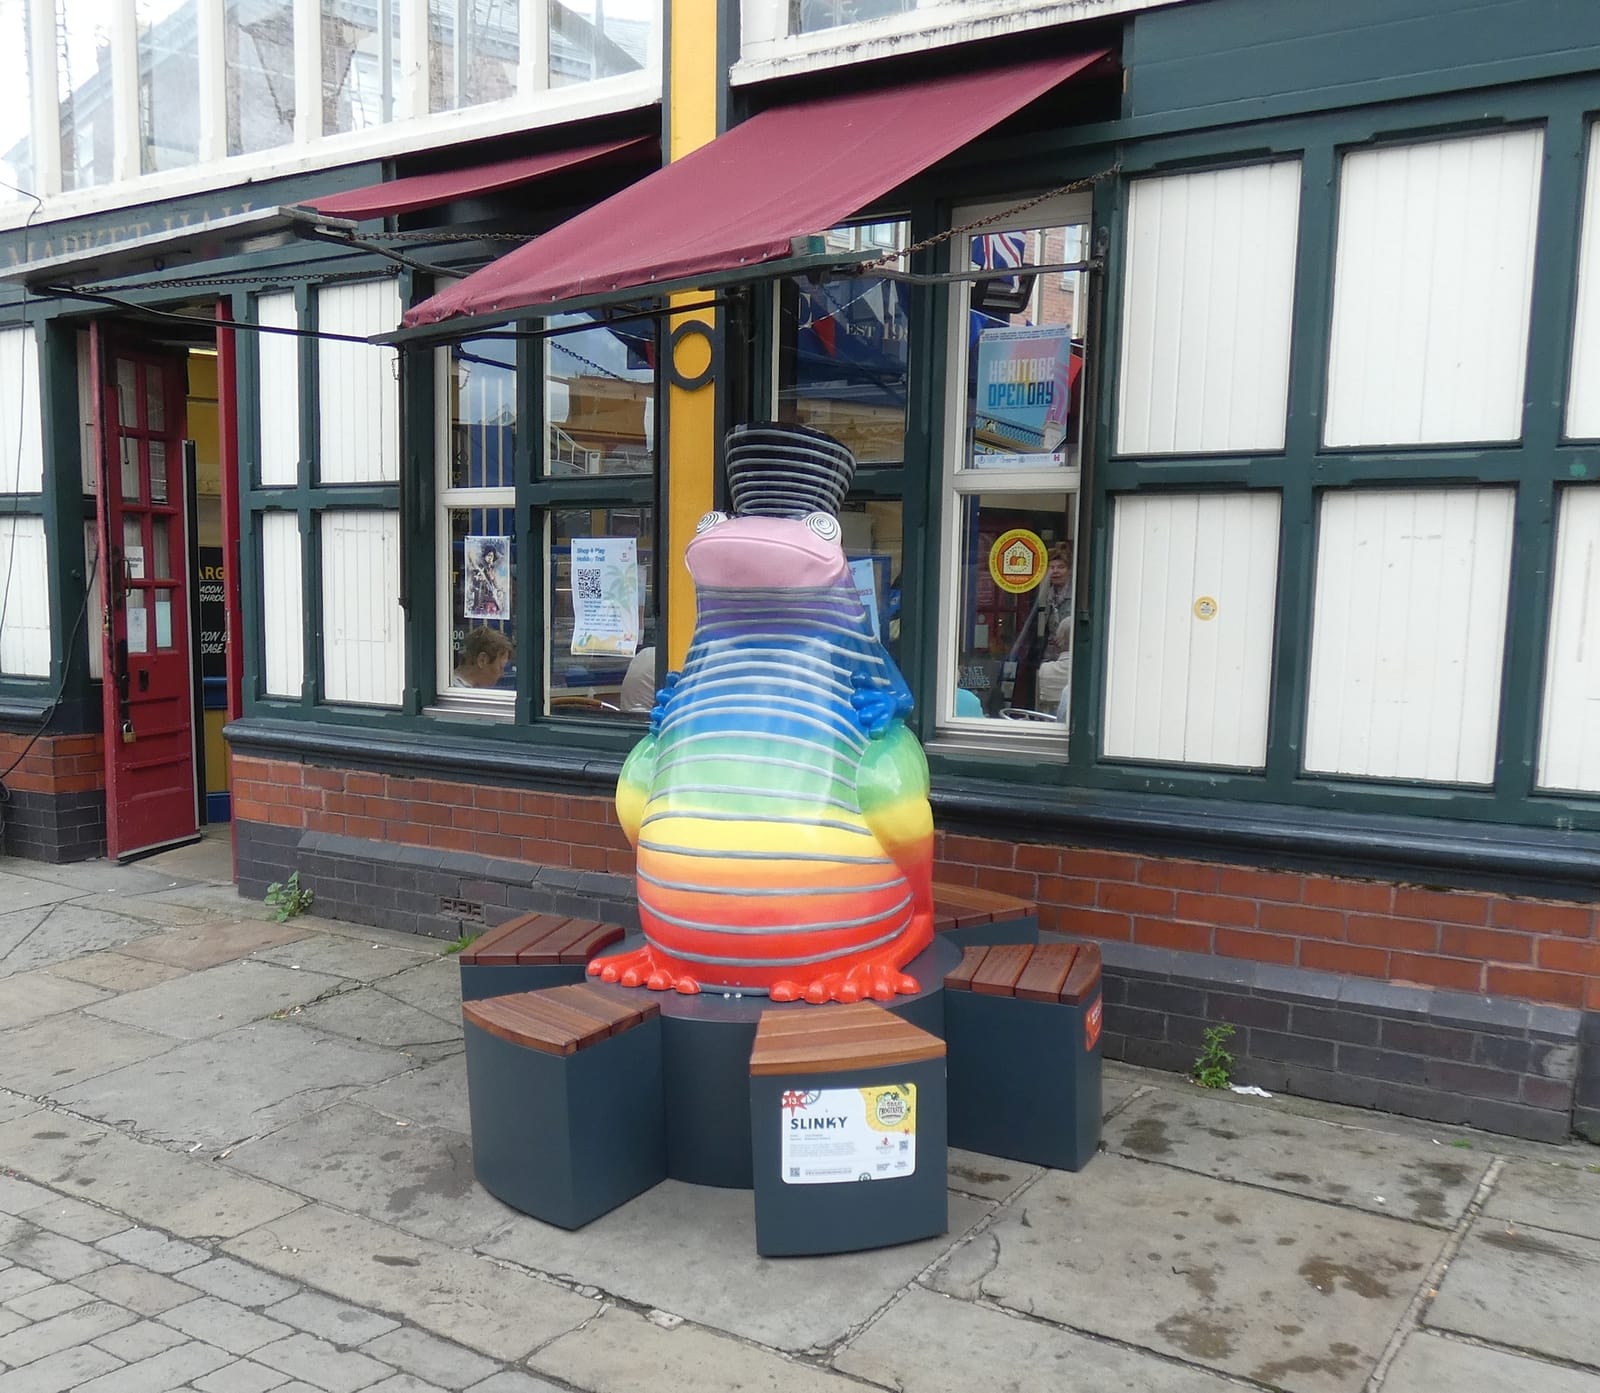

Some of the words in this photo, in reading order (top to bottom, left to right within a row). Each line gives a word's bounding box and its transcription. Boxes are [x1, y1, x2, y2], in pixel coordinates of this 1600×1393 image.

[989, 357, 1056, 382] HERITAGE
[988, 382, 1025, 407] OPEN
[1027, 380, 1055, 405] DAY
[790, 1116, 848, 1130] SLINKY
